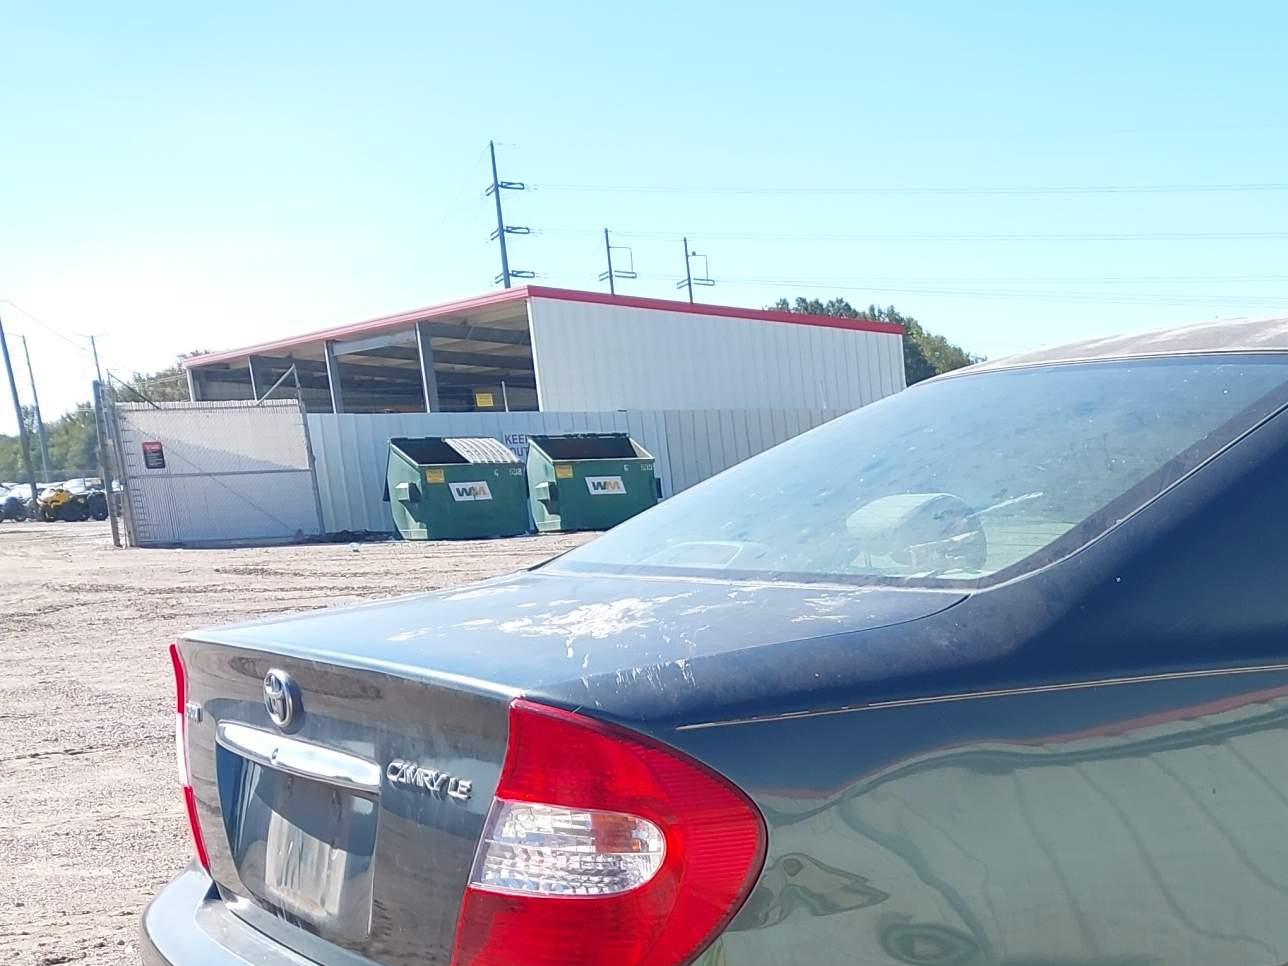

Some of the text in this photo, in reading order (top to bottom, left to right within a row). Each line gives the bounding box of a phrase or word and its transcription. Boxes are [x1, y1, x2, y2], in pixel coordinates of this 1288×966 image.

[456, 486, 487, 497] WM
[591, 481, 621, 491] WM
[386, 759, 473, 800] CAMRY LE
